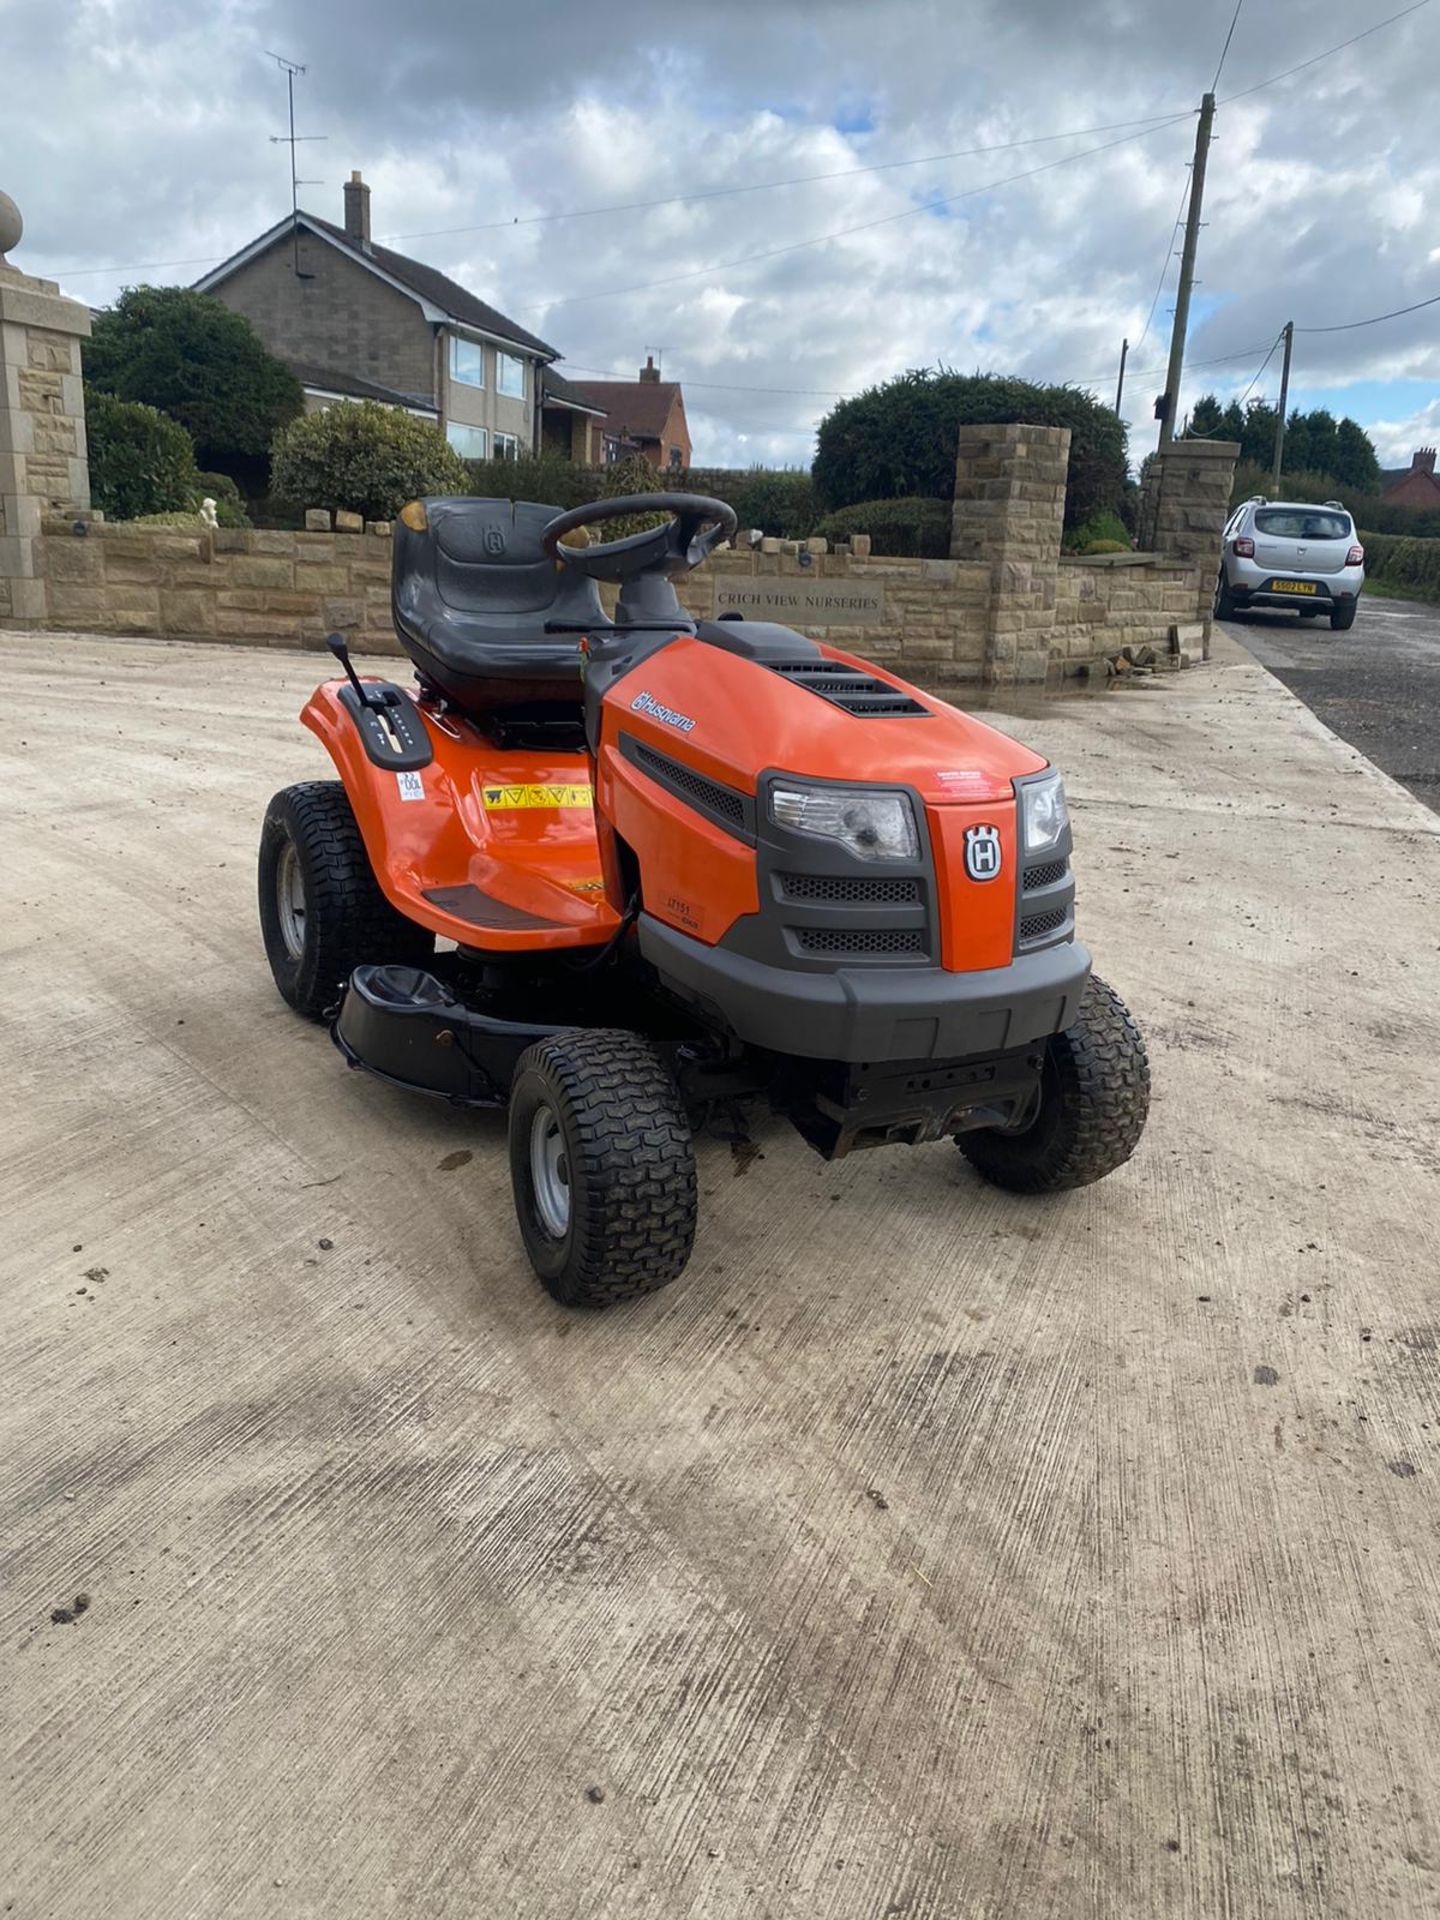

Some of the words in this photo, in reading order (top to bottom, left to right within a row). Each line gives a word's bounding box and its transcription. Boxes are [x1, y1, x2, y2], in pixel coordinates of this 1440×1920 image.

[718, 593, 761, 605] CRICH
[765, 594, 798, 607] VIEW
[805, 595, 879, 610] NURSERIES
[641, 697, 697, 732] Husqvarna
